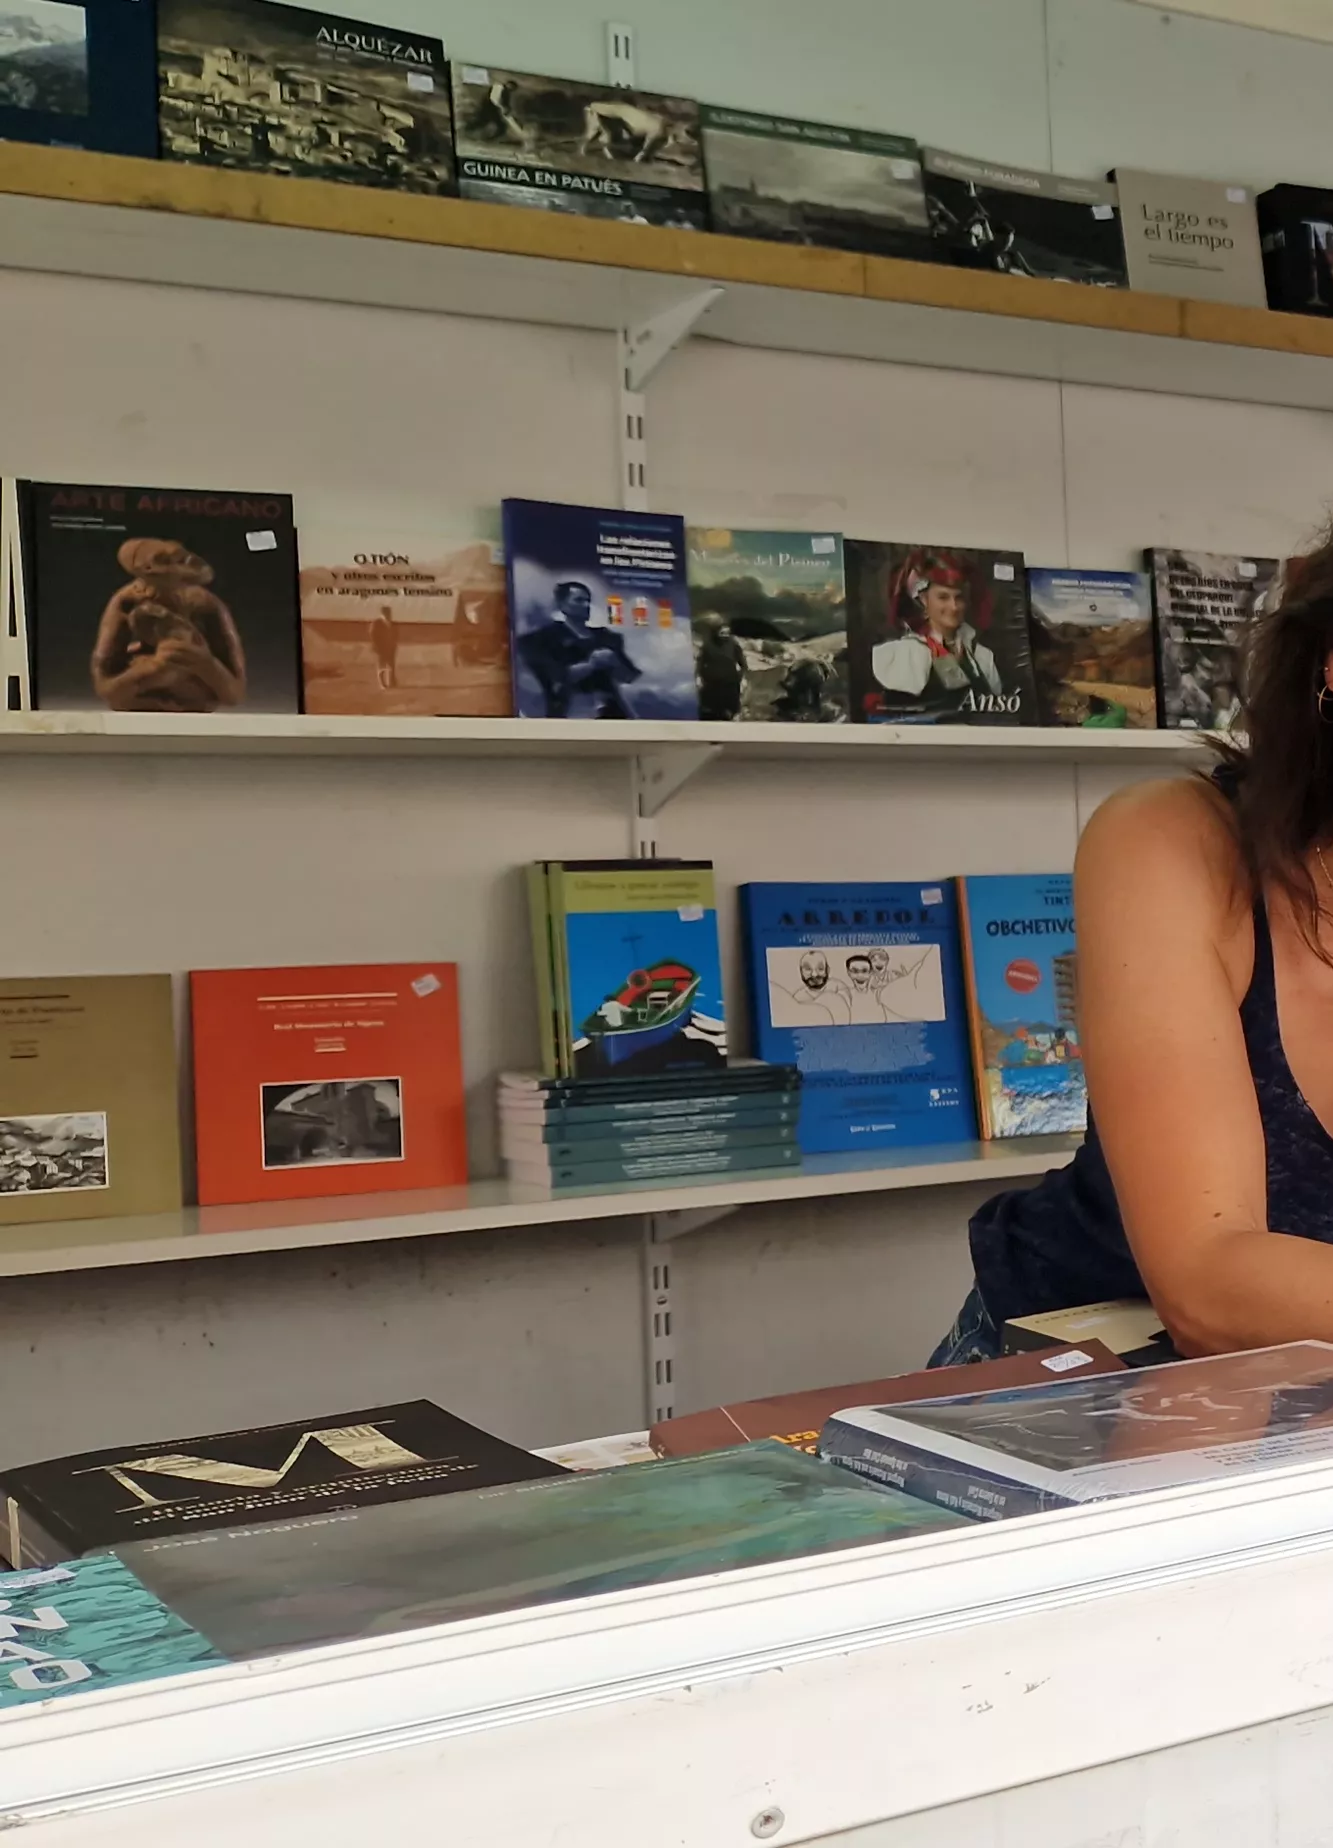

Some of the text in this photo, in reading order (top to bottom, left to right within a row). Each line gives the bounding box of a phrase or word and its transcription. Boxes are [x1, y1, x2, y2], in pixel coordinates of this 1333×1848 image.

[464, 161, 623, 196] GUINEA EN PATUÉS
[1142, 203, 1229, 230] Largo es
[1144, 223, 1235, 252] el tiempo
[52, 491, 282, 519] ARTE AFRICANO
[316, 586, 333, 596] en
[1044, 896, 1070, 906] TINT
[72, 1419, 459, 1514] M
